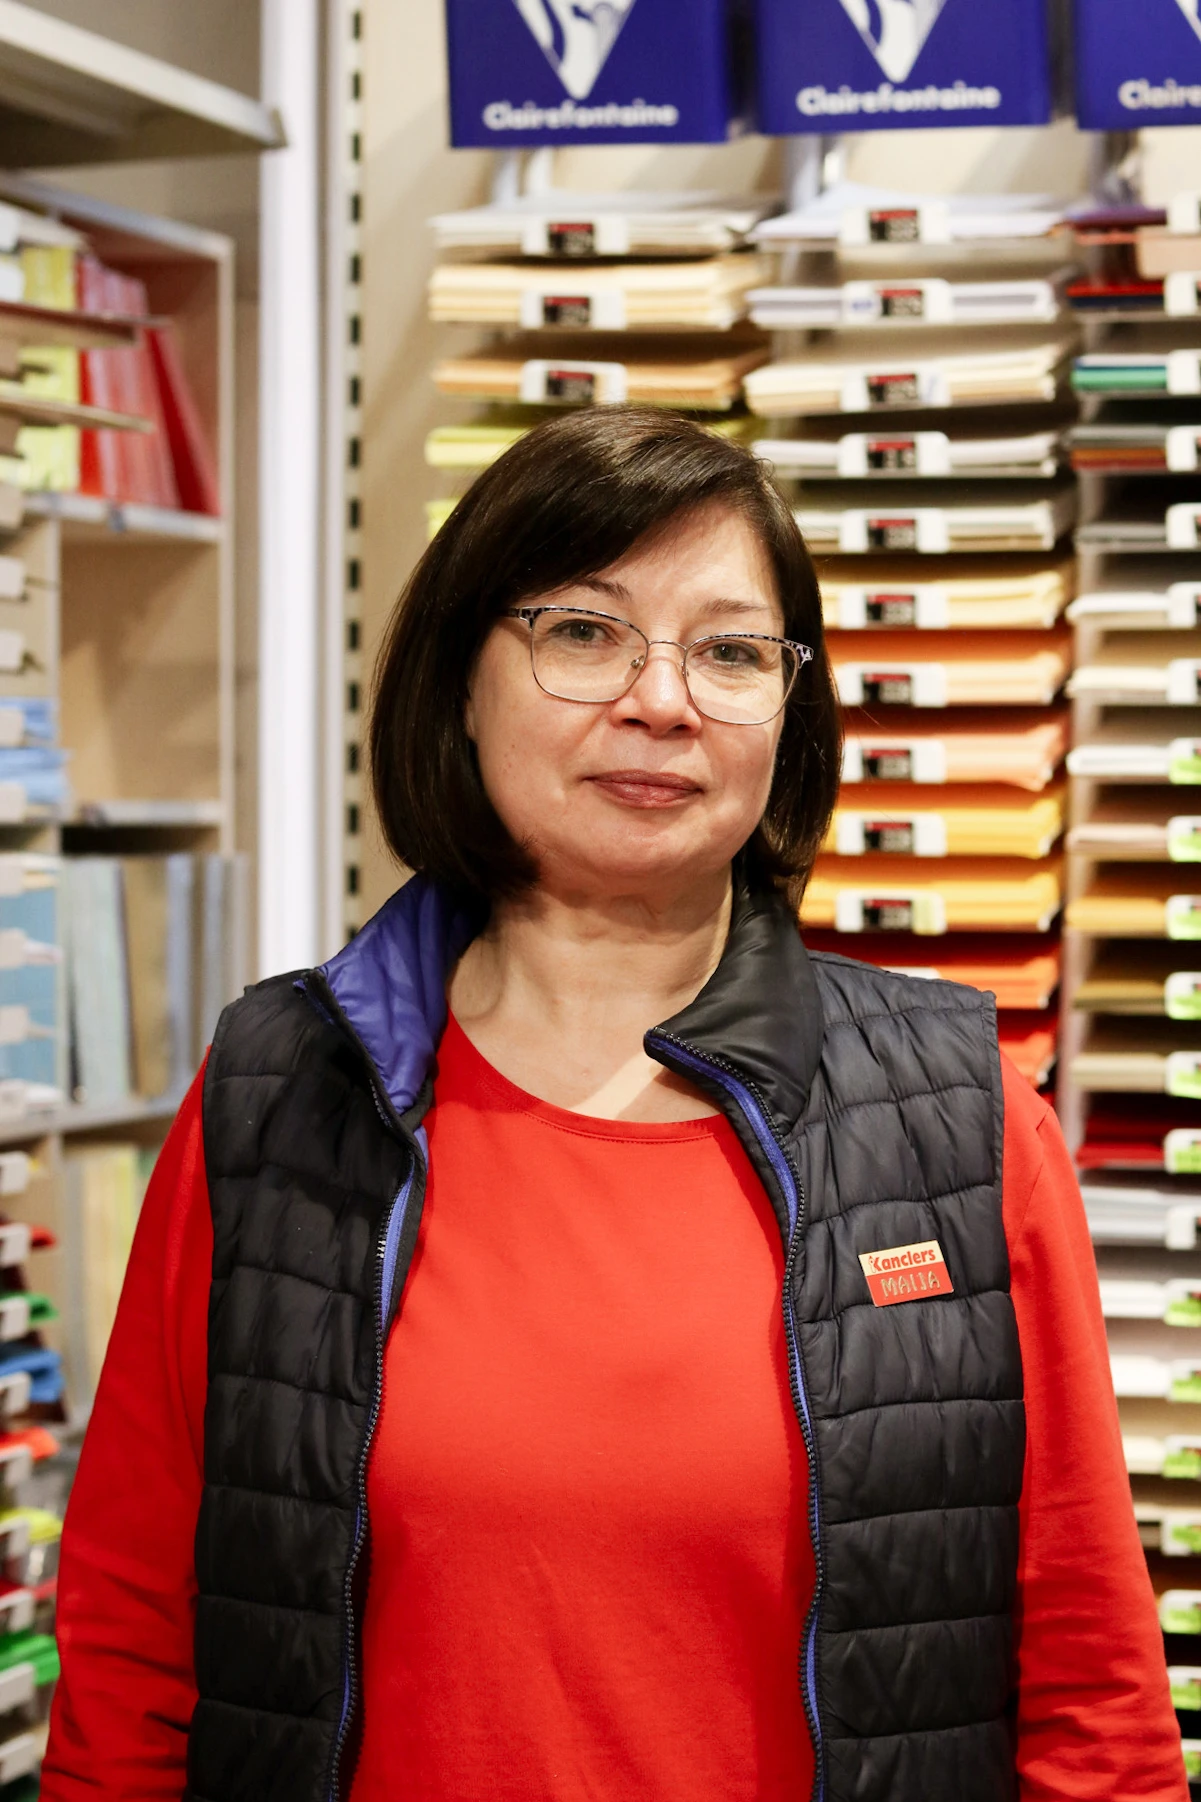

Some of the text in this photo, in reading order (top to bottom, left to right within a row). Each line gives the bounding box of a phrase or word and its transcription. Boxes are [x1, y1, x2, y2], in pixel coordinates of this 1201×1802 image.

[795, 82, 1001, 117] Clairefontaine
[482, 101, 679, 131] Clairefontaine
[868, 1249, 936, 1273] Kanclers
[880, 1270, 941, 1298] MAIJA
